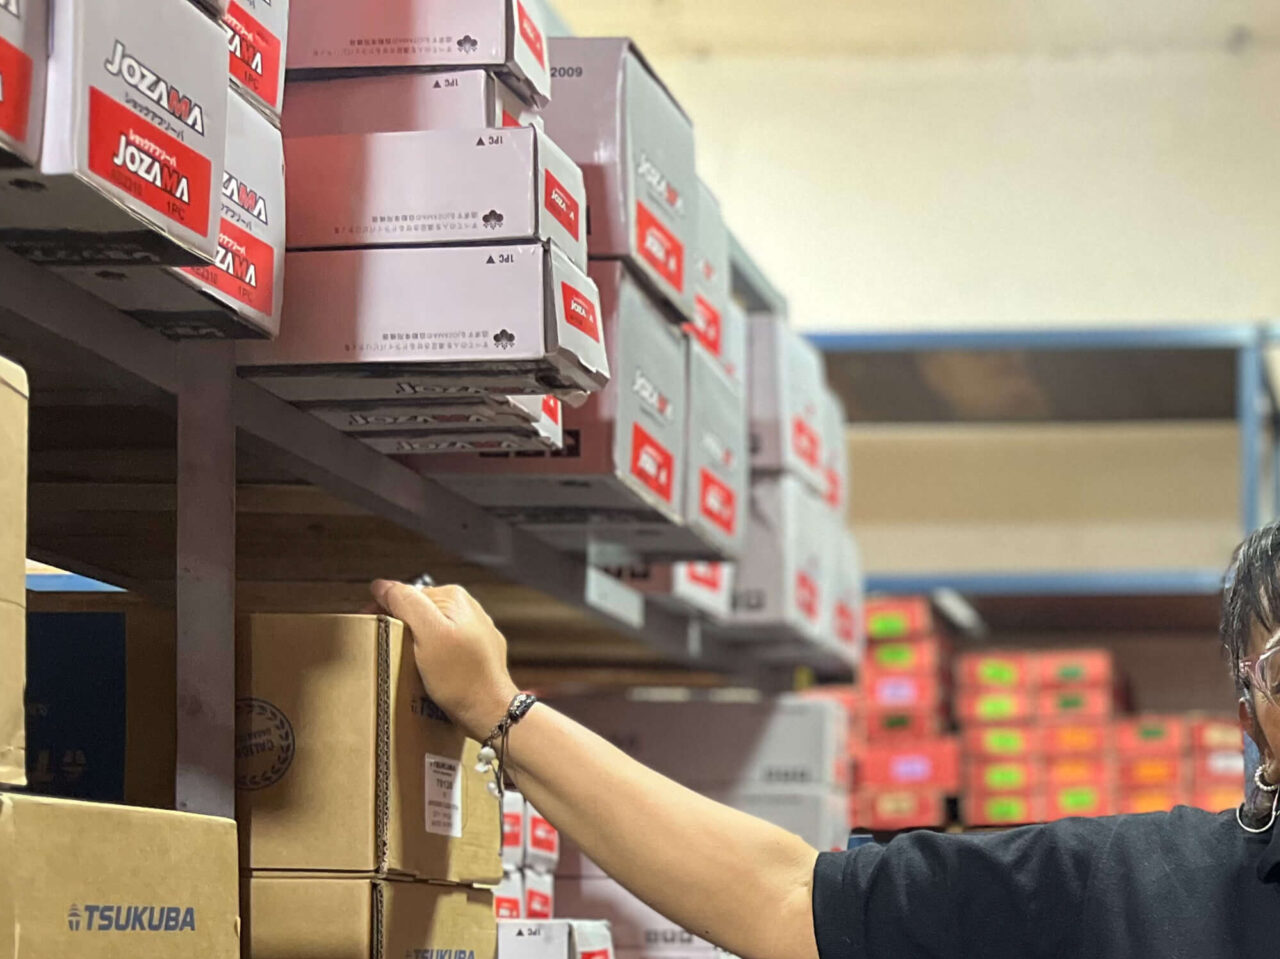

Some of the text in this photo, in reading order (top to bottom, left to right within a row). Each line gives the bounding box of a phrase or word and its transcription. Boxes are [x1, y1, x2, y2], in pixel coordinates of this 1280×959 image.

[226, 26, 263, 76] ZAMA
[104, 38, 204, 137] JOZAMA
[444, 78, 459, 88] 1PC
[550, 66, 584, 78] 2009
[488, 135, 504, 145] 1PC
[112, 132, 190, 205] JOZAMA
[221, 170, 268, 226] ZAMA
[214, 243, 257, 289] ZAMA
[498, 254, 515, 264] 1PC
[84, 904, 196, 932] TSUKUBA
